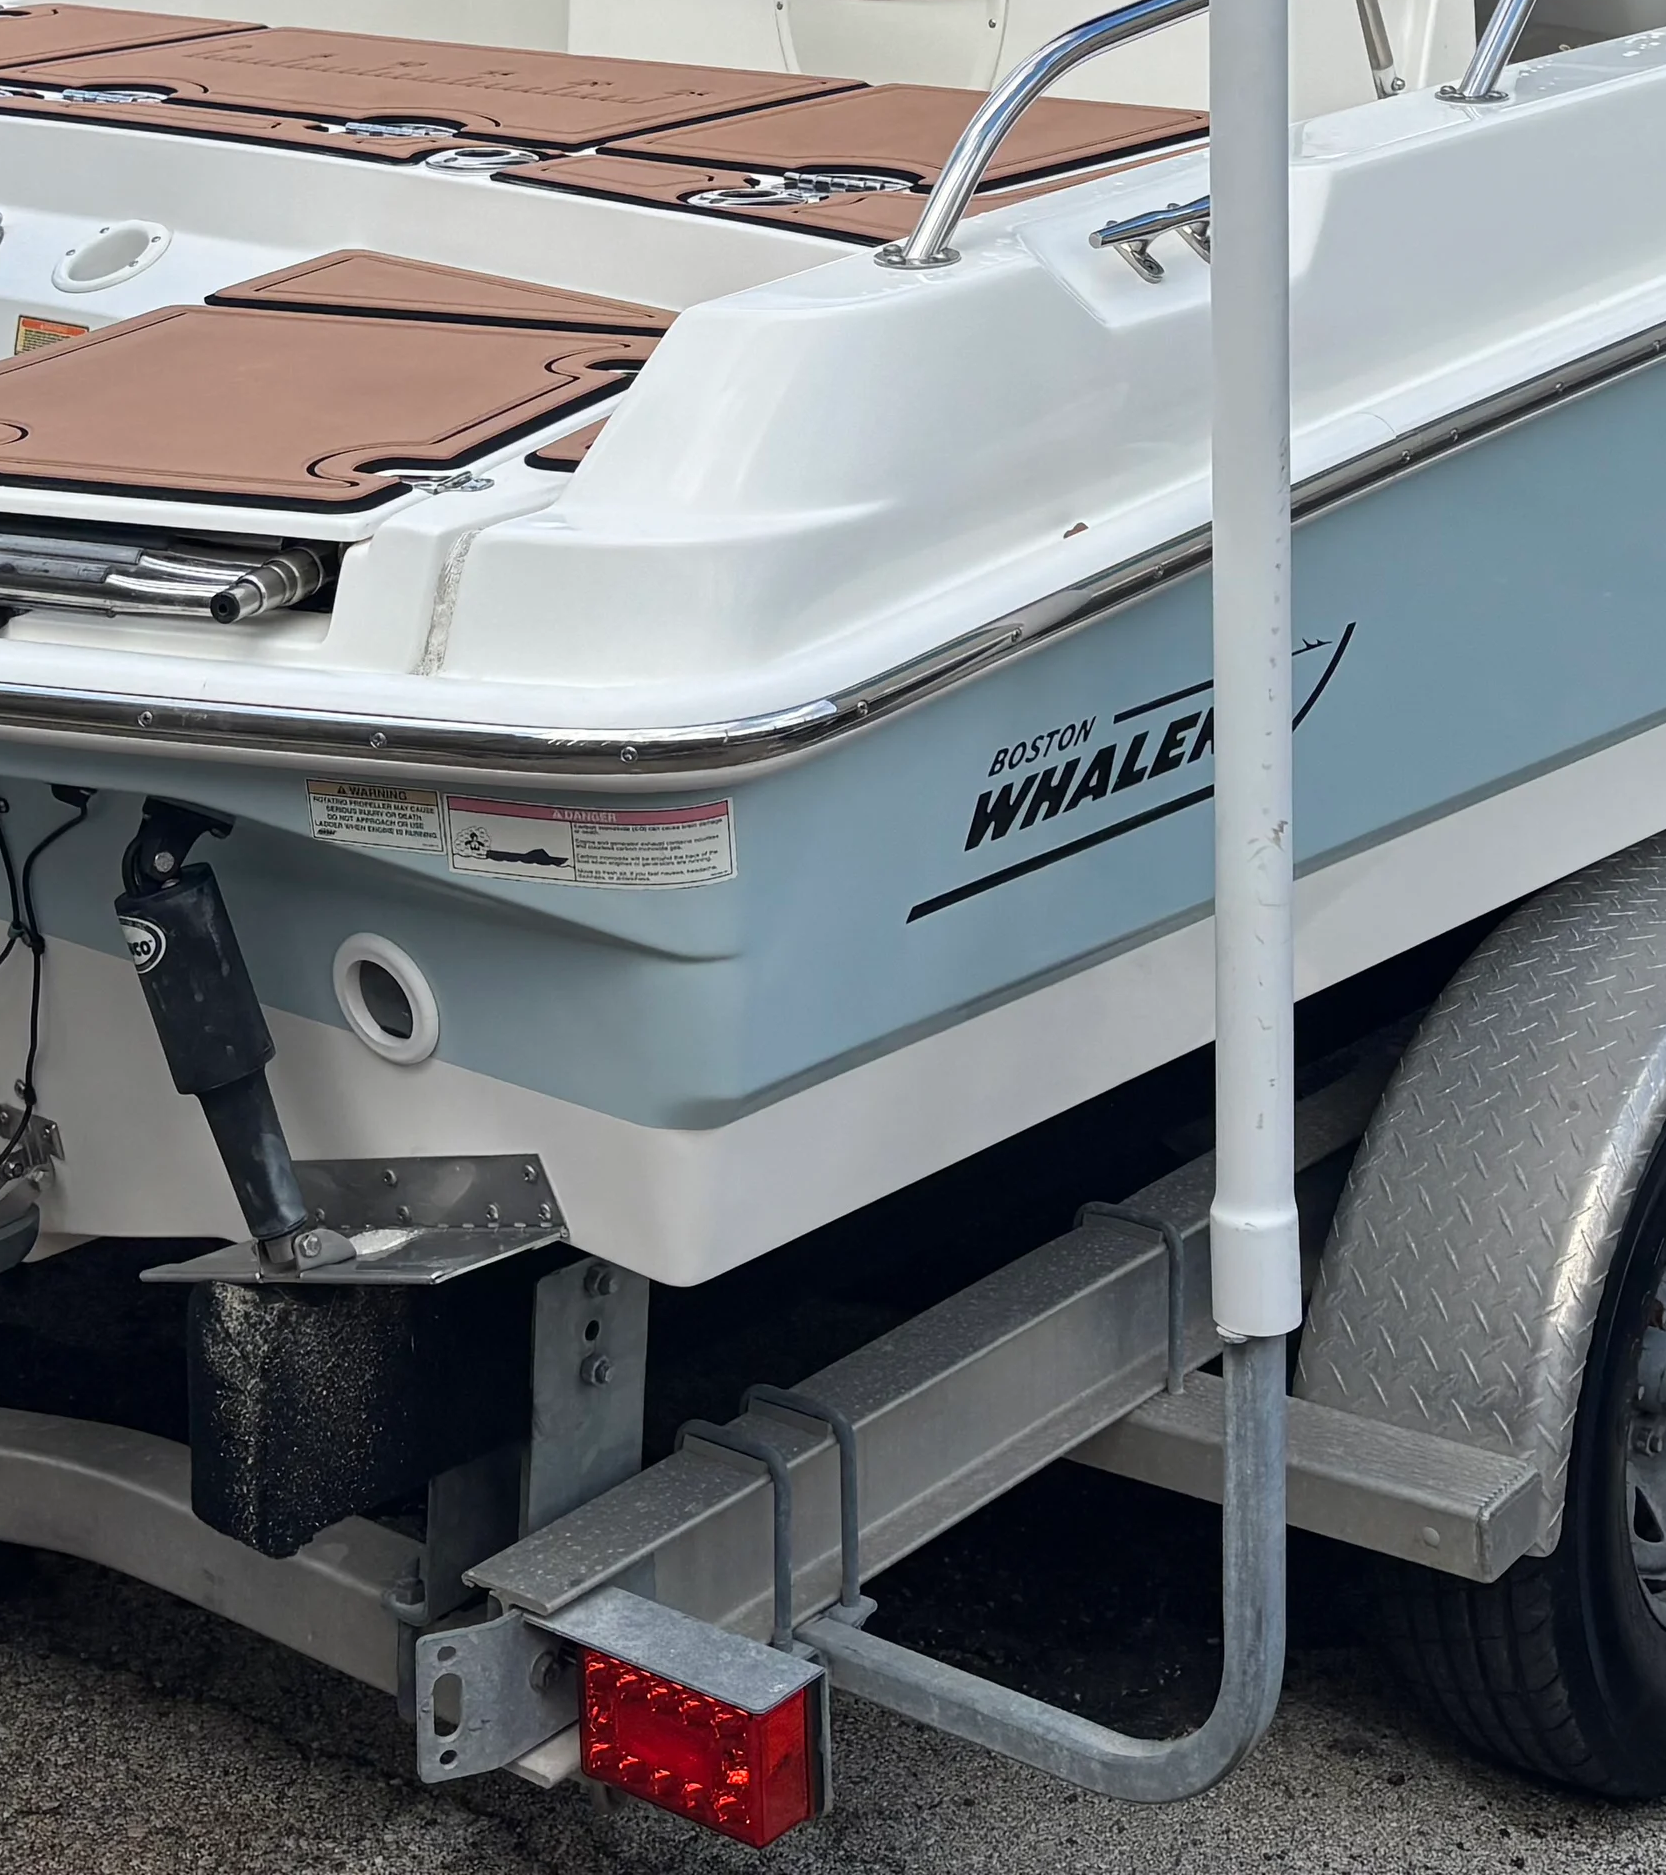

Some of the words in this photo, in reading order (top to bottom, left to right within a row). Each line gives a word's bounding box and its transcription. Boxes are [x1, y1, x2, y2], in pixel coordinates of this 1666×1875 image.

[988, 715, 1096, 777] BOSTON
[348, 785, 408, 801] WARNING
[326, 805, 357, 815] SERIOUS
[349, 799, 393, 811] PROPELLER
[394, 804, 409, 812] MAY
[410, 806, 435, 815] CAUSE
[327, 813, 338, 821] DO
[339, 815, 354, 823] NOT
[356, 816, 396, 827] APPROACH
[397, 820, 409, 828] OR
[410, 821, 424, 830] USE
[563, 809, 617, 823] DANGER
[315, 820, 343, 829] LADDER
[345, 823, 366, 832] WHEN
[368, 826, 394, 835] ENGINE
